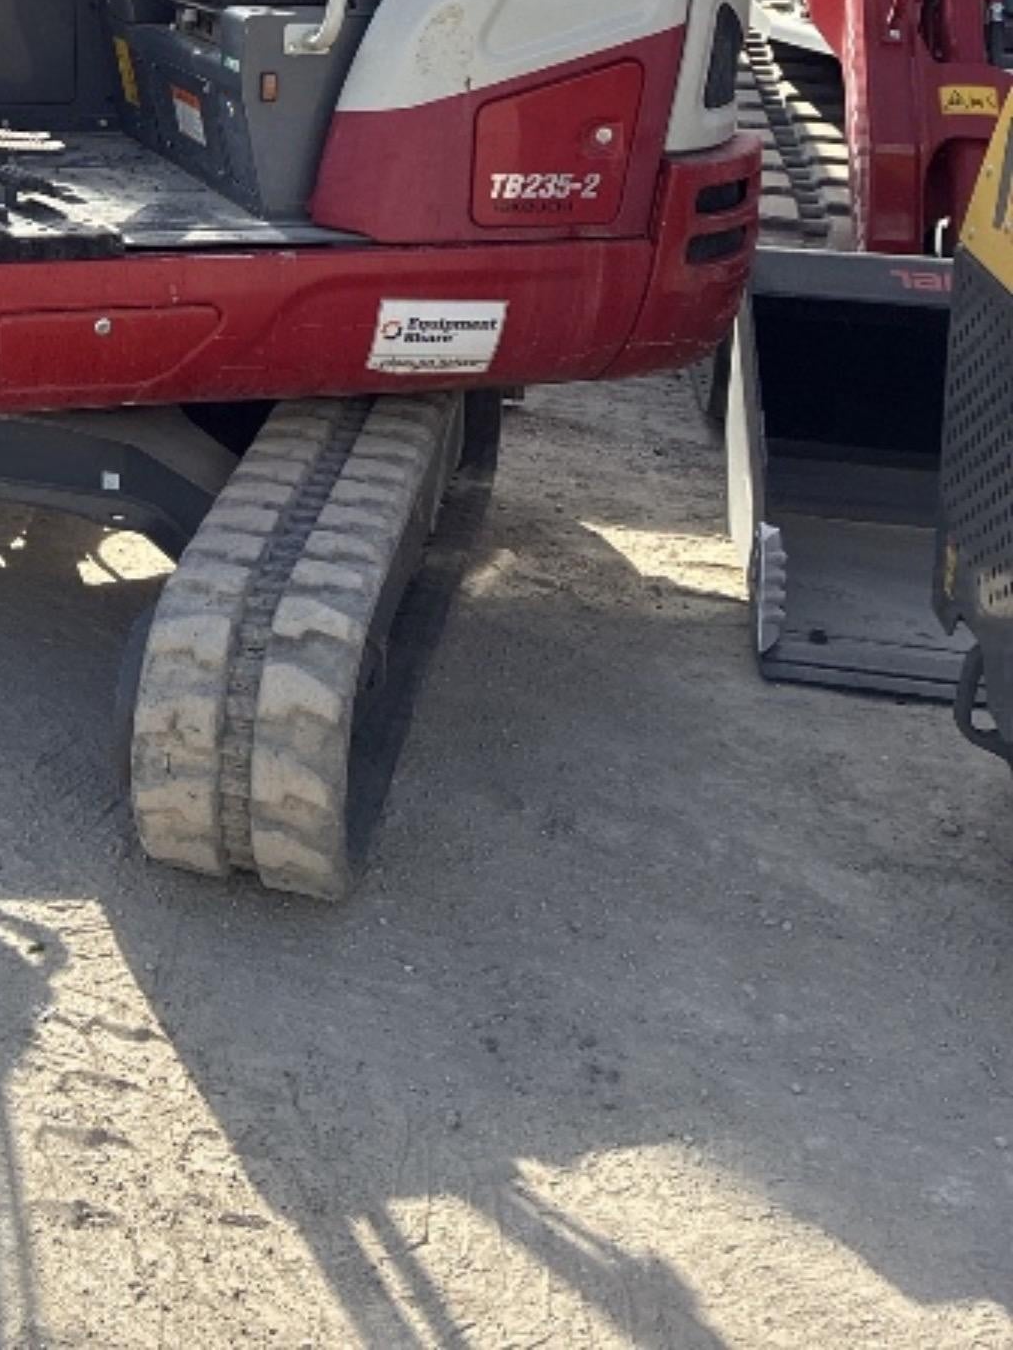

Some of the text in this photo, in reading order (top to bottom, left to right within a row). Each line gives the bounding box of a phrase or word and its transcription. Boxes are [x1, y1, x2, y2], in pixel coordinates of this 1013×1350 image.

[490, 172, 601, 199] TB235-2
[406, 316, 498, 332] Equipment
[403, 331, 454, 344] Share
